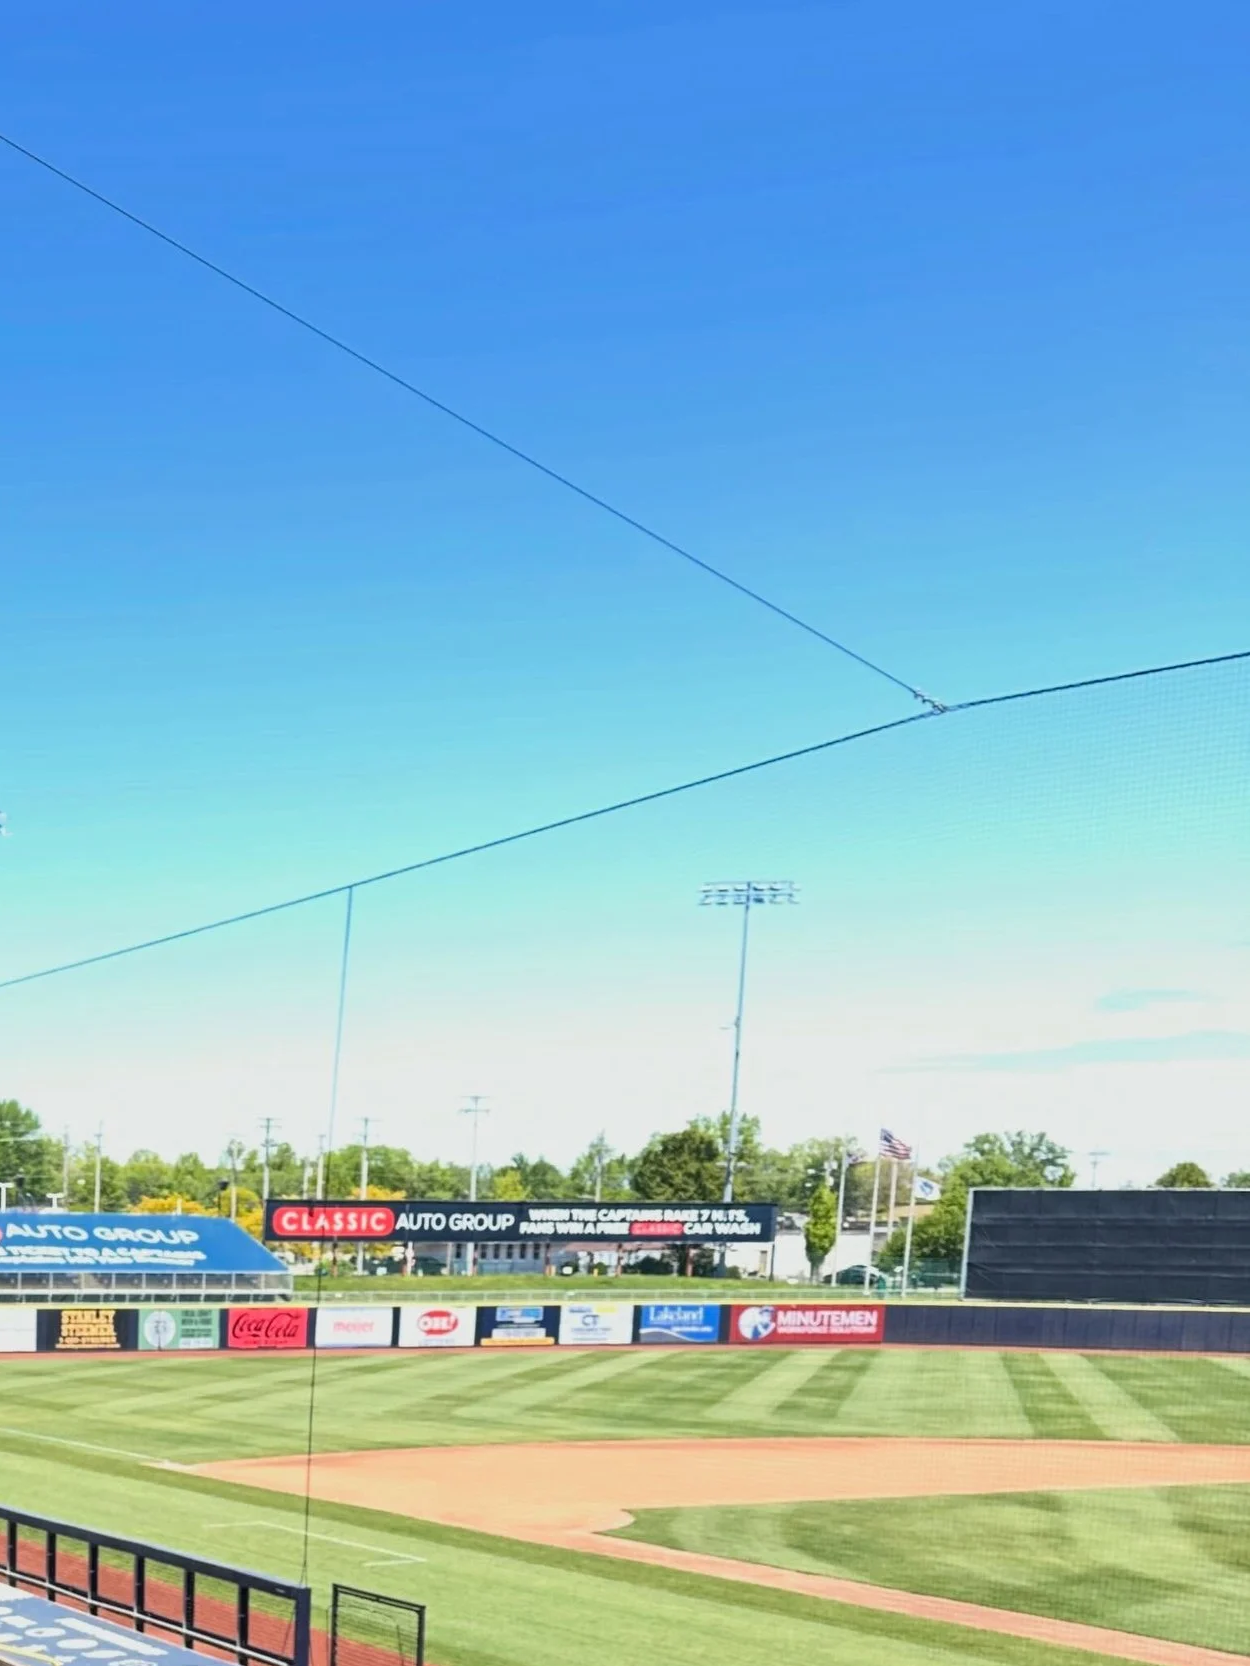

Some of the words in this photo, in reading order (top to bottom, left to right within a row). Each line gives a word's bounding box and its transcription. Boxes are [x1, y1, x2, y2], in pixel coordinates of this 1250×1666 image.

[280, 1211, 387, 1232] CLASSIC
[394, 1212, 446, 1232] AUTO
[448, 1212, 516, 1232] GROUP
[571, 1208, 597, 1222] THE
[597, 1208, 663, 1222] CAPTAINS
[6, 1223, 89, 1242] AUTO
[93, 1226, 200, 1245] GROUP
[582, 1221, 596, 1235] A
[683, 1221, 716, 1235] CAR
[716, 1221, 762, 1235] WASH
[60, 1309, 116, 1324] STANLEY
[649, 1306, 705, 1322] Lakeland
[776, 1310, 878, 1327] MINUTEMEN
[333, 1320, 375, 1335] meijer
